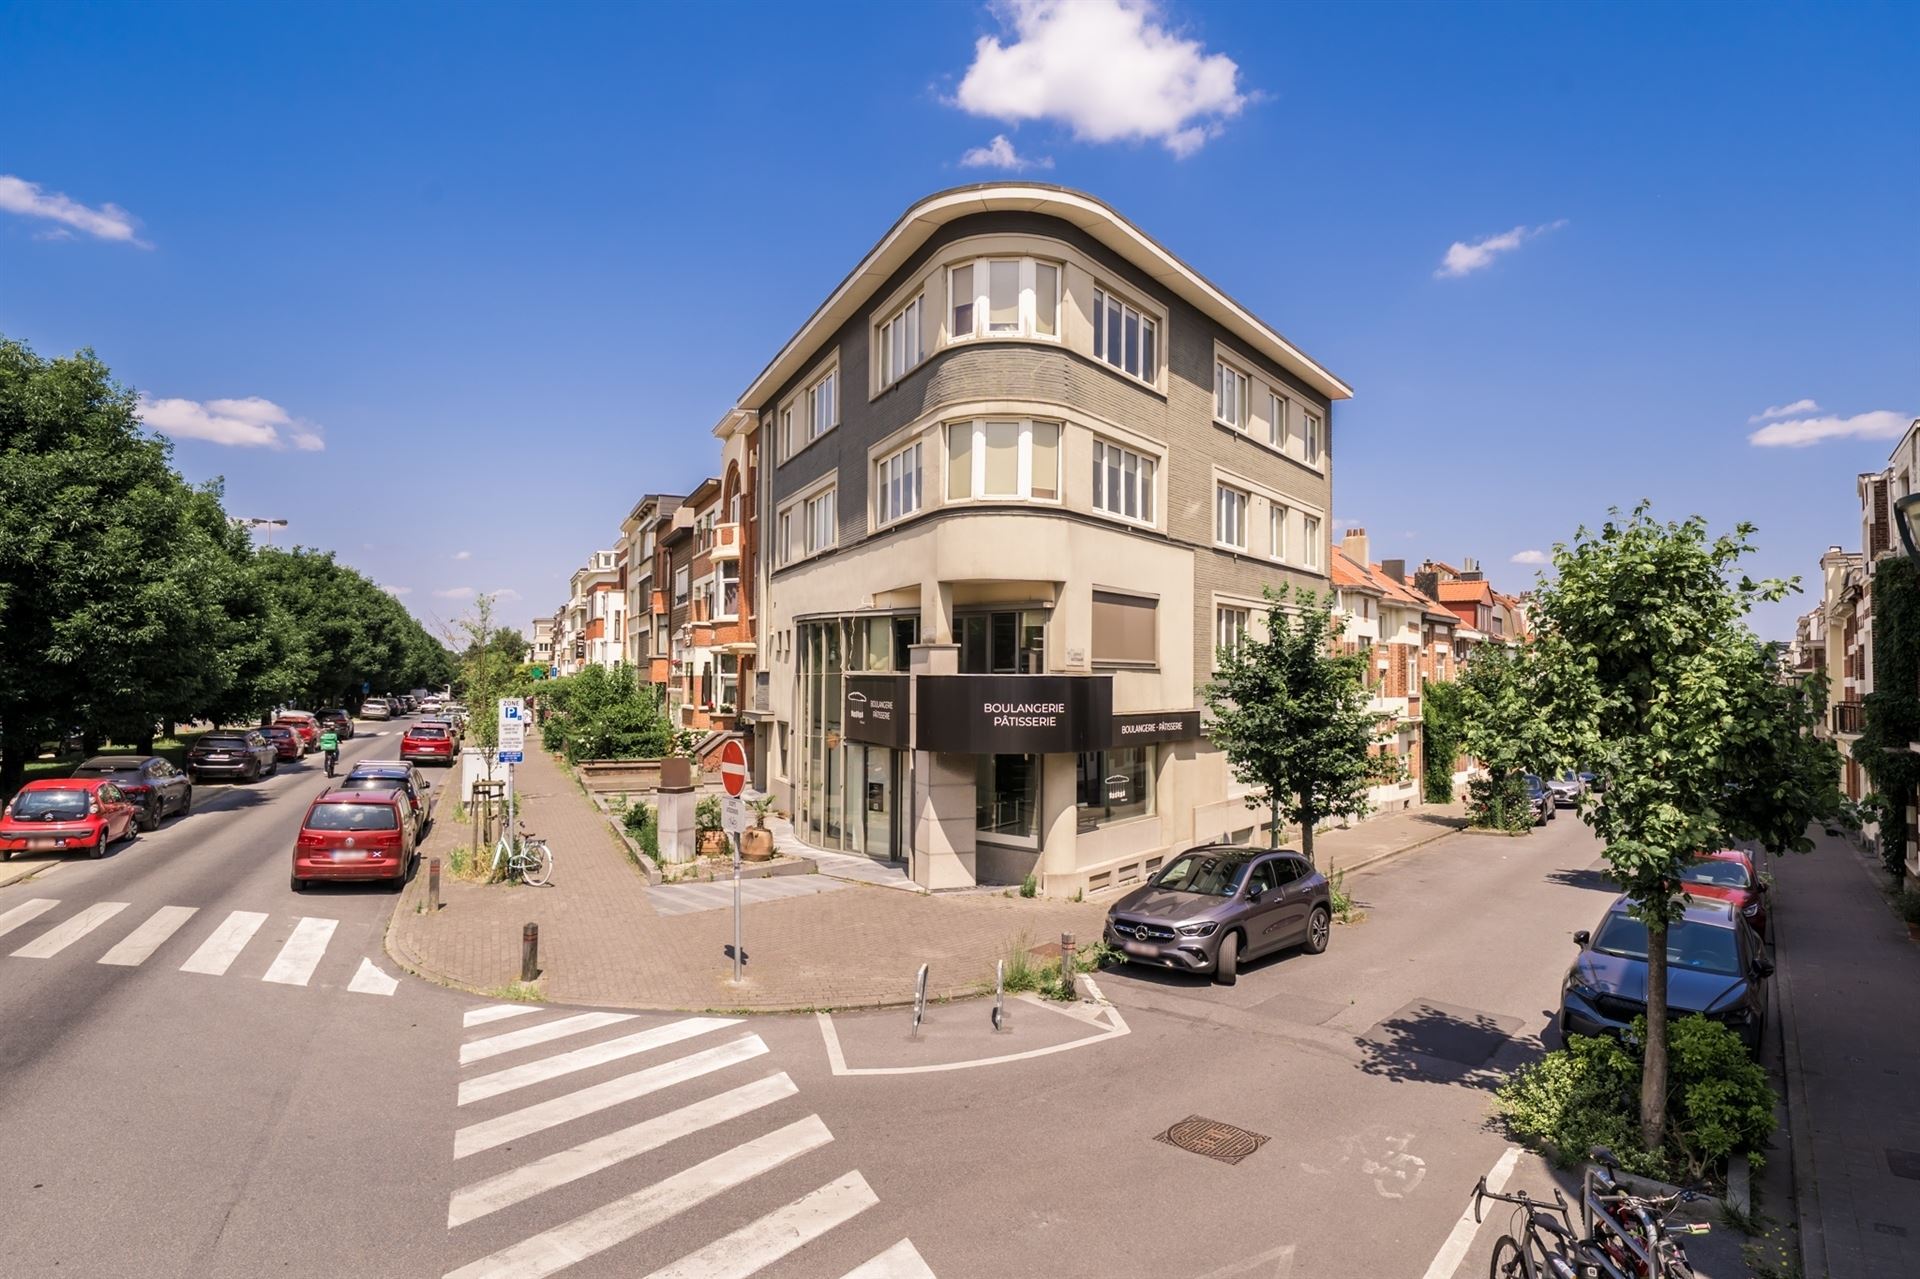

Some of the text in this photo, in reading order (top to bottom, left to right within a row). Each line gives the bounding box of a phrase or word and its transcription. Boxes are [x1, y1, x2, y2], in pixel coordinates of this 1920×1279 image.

[984, 703, 1065, 713] BOULANGERIE
[994, 714, 1056, 726] PÂTISSERIE
[1121, 723, 1156, 735] BOULANGERIE
[1159, 721, 1183, 731] PÂTISSERIE
